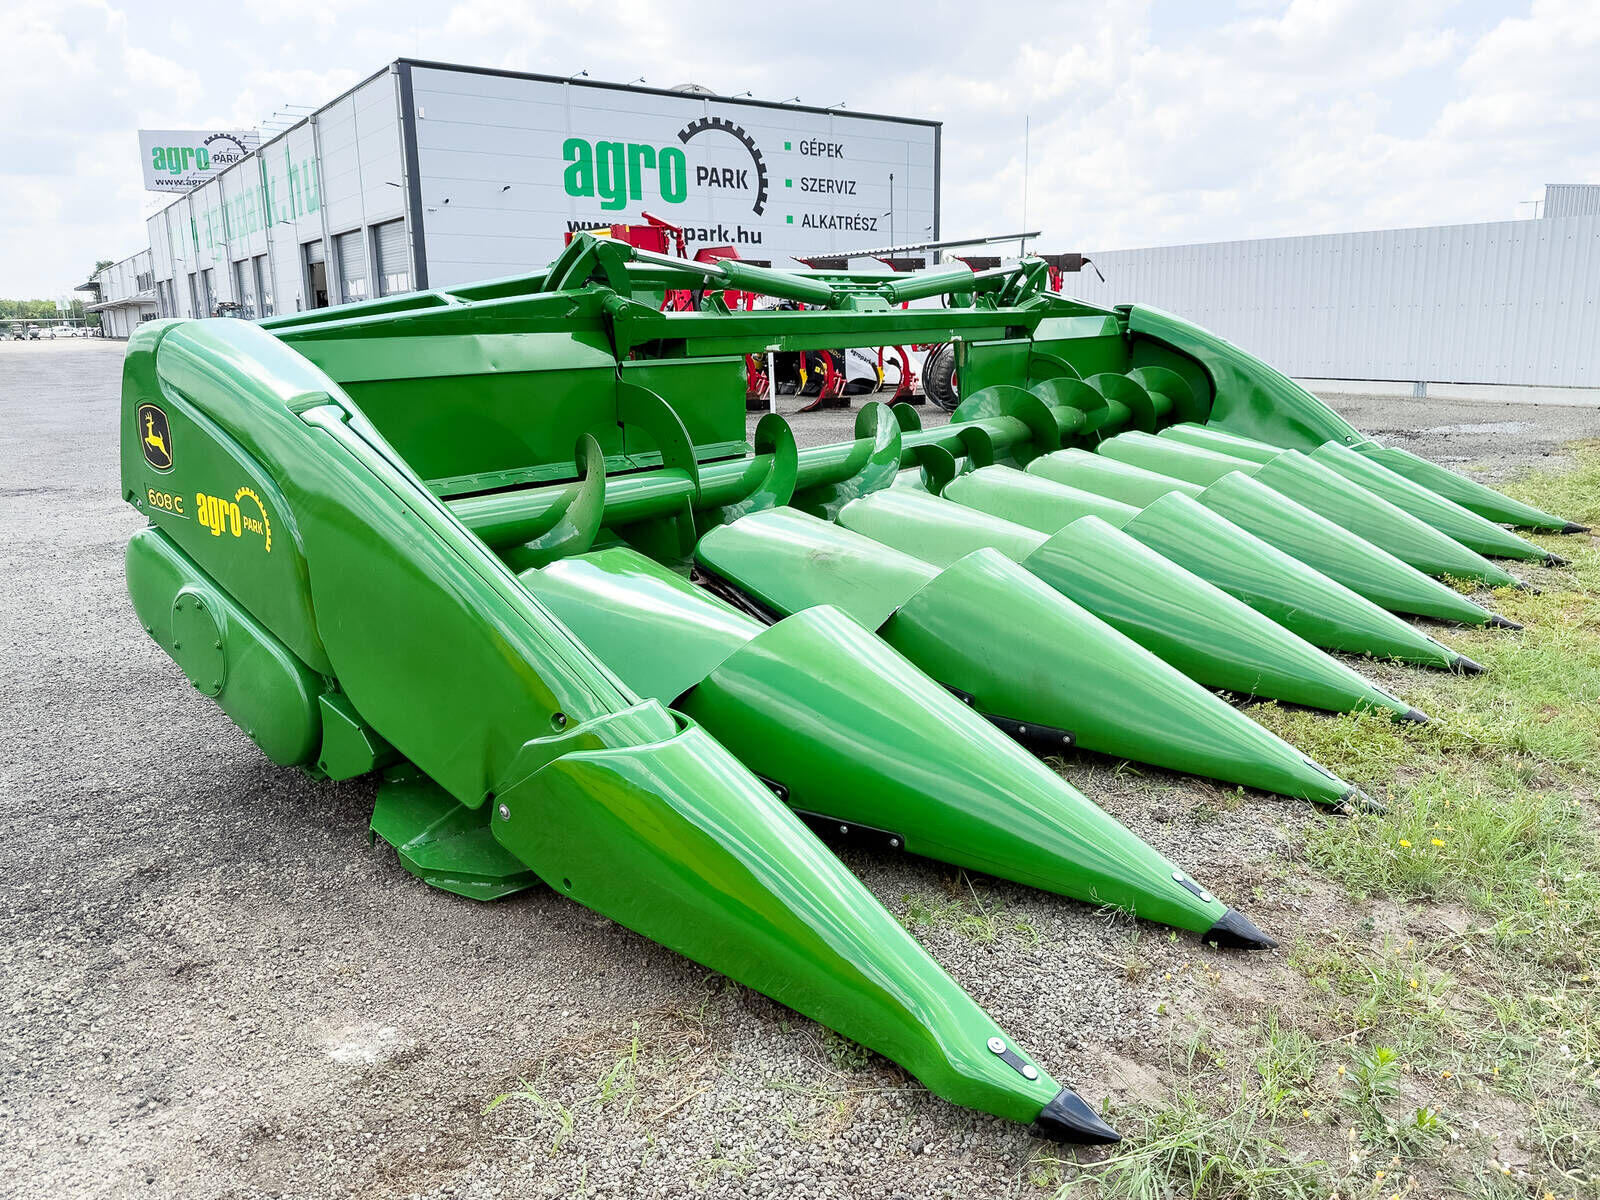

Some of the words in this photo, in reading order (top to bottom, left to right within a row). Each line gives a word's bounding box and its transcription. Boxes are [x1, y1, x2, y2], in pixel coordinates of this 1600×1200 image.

[151, 146, 210, 175] agro
[799, 139, 844, 160] GÉPEK
[563, 137, 688, 211] agro
[696, 165, 749, 191] PARK
[800, 177, 857, 196] SZERVIZ
[801, 212, 878, 232] ALKATRÉSZ
[148, 488, 172, 511] 608
[174, 496, 184, 514] C
[196, 492, 241, 537] agro
[243, 516, 264, 535] PARK
